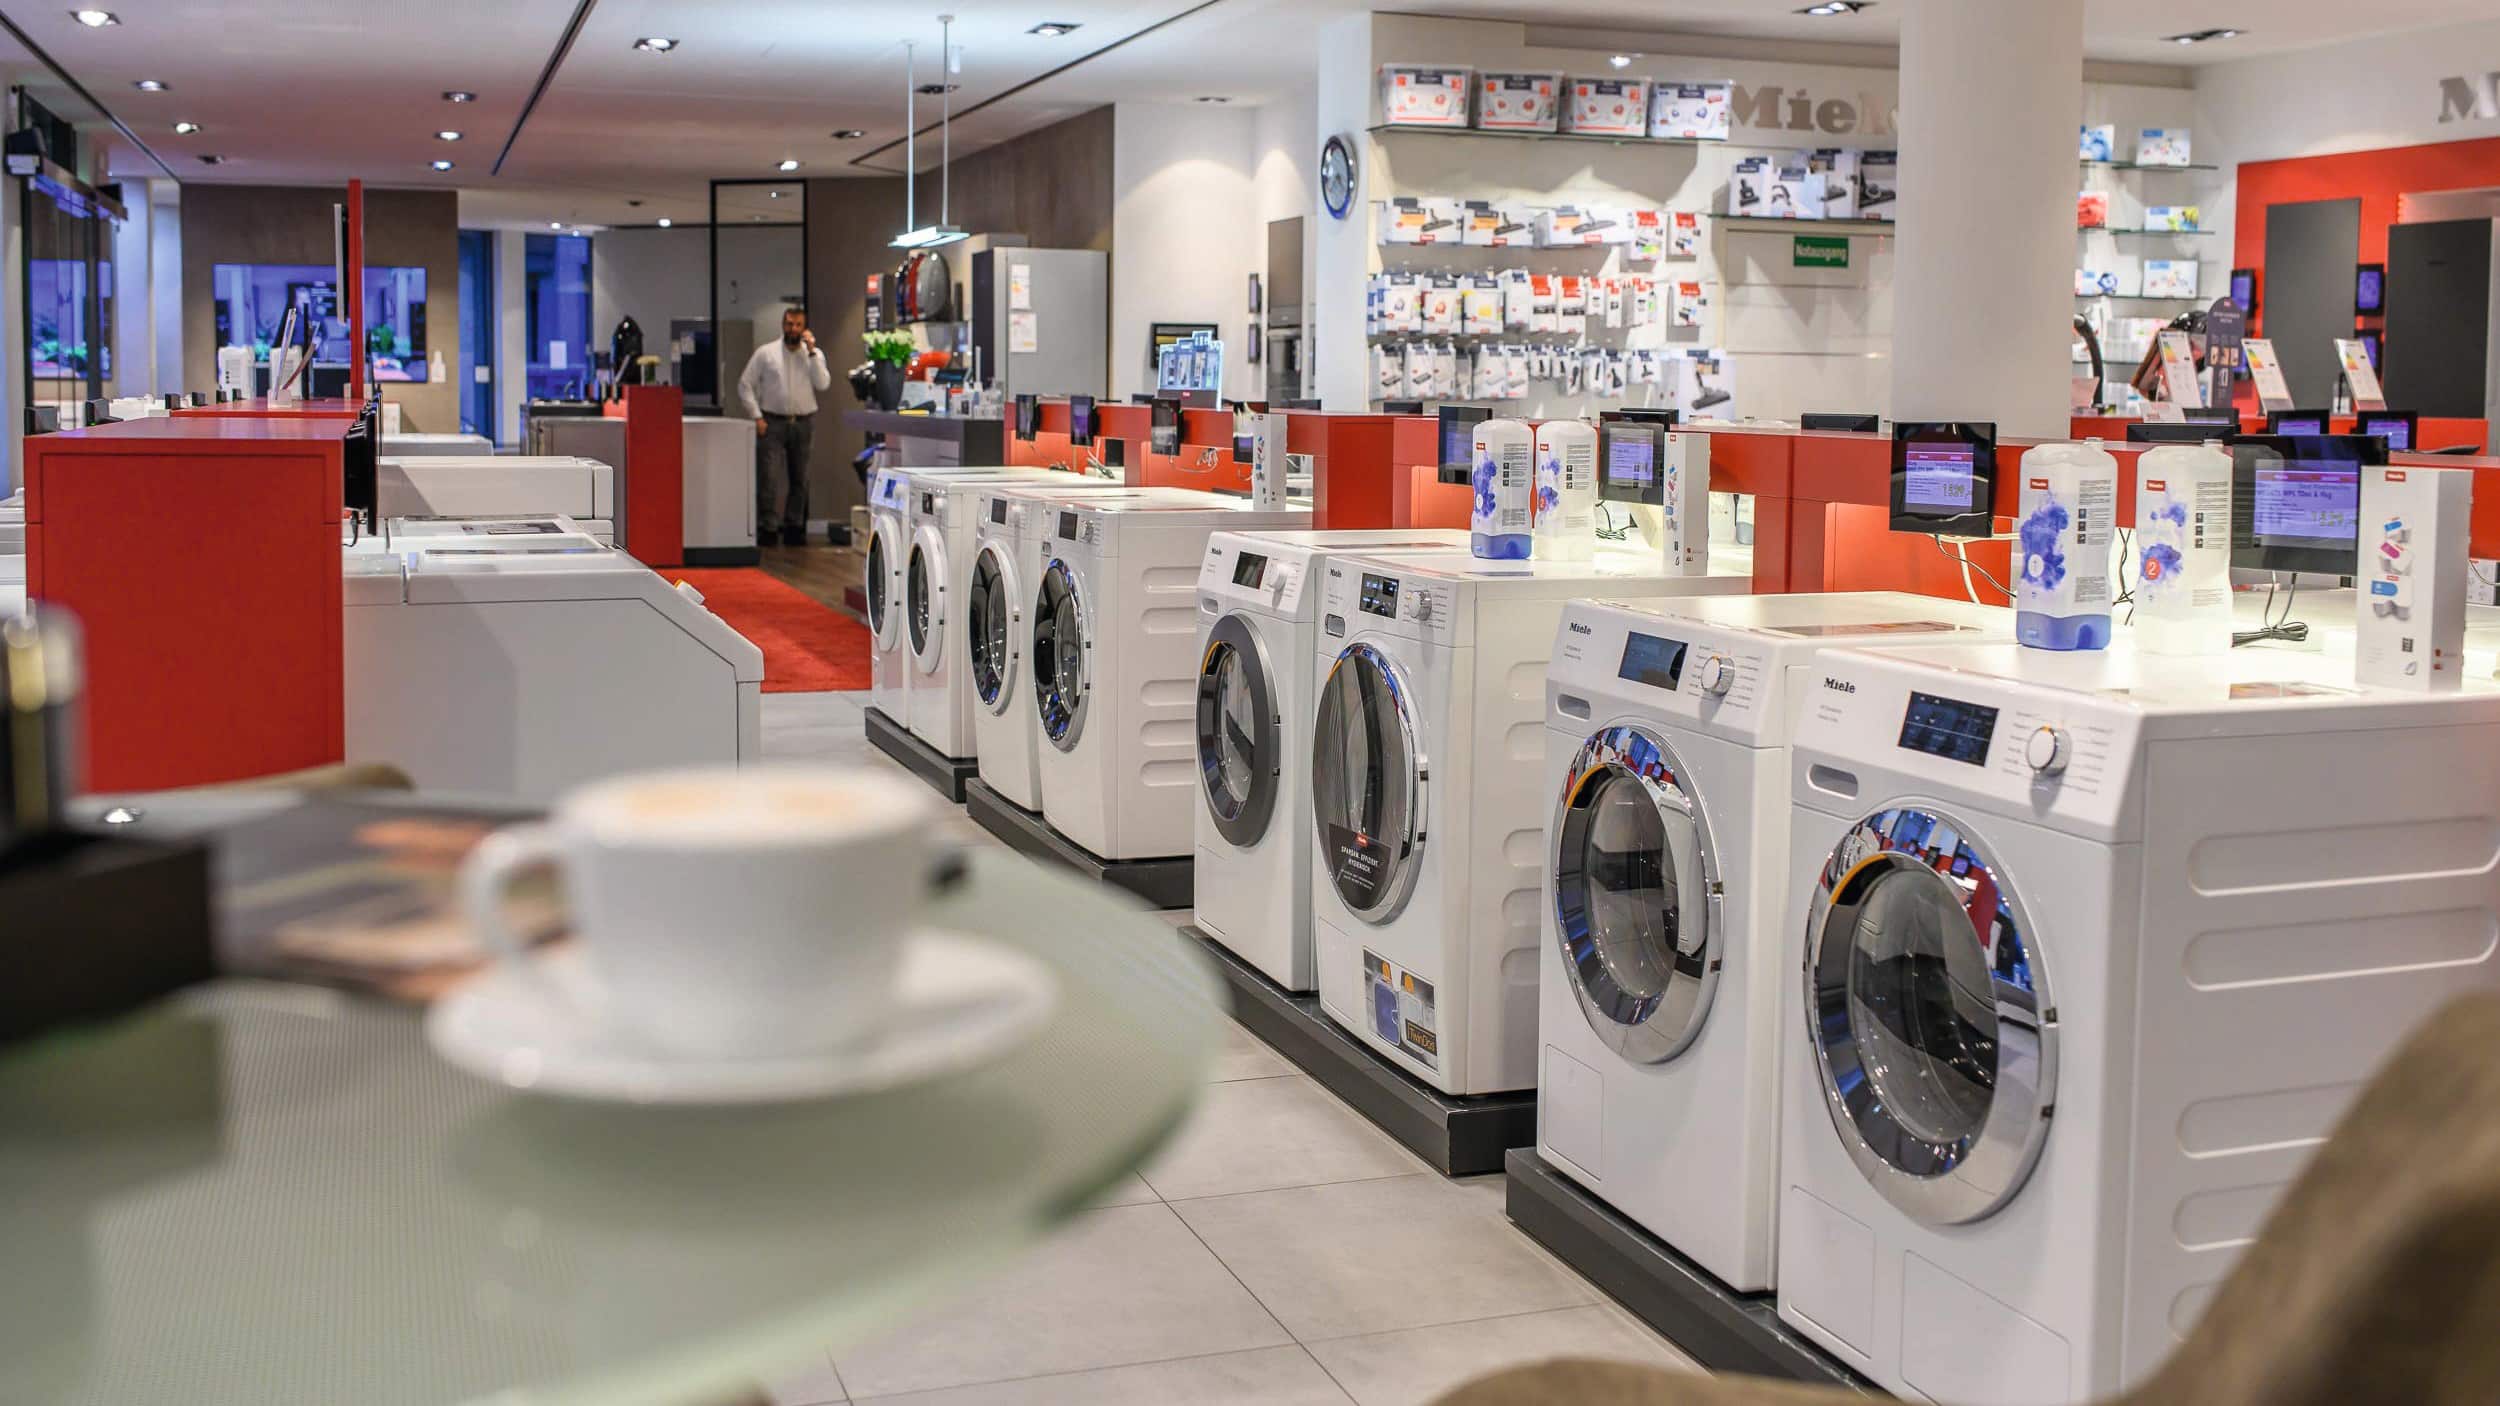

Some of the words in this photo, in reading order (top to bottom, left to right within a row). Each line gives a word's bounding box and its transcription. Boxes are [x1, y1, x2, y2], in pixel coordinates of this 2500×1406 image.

[2147, 561, 2157, 576] 2
[1569, 622, 1591, 635] Miele
[1823, 677, 1856, 693] Miele
